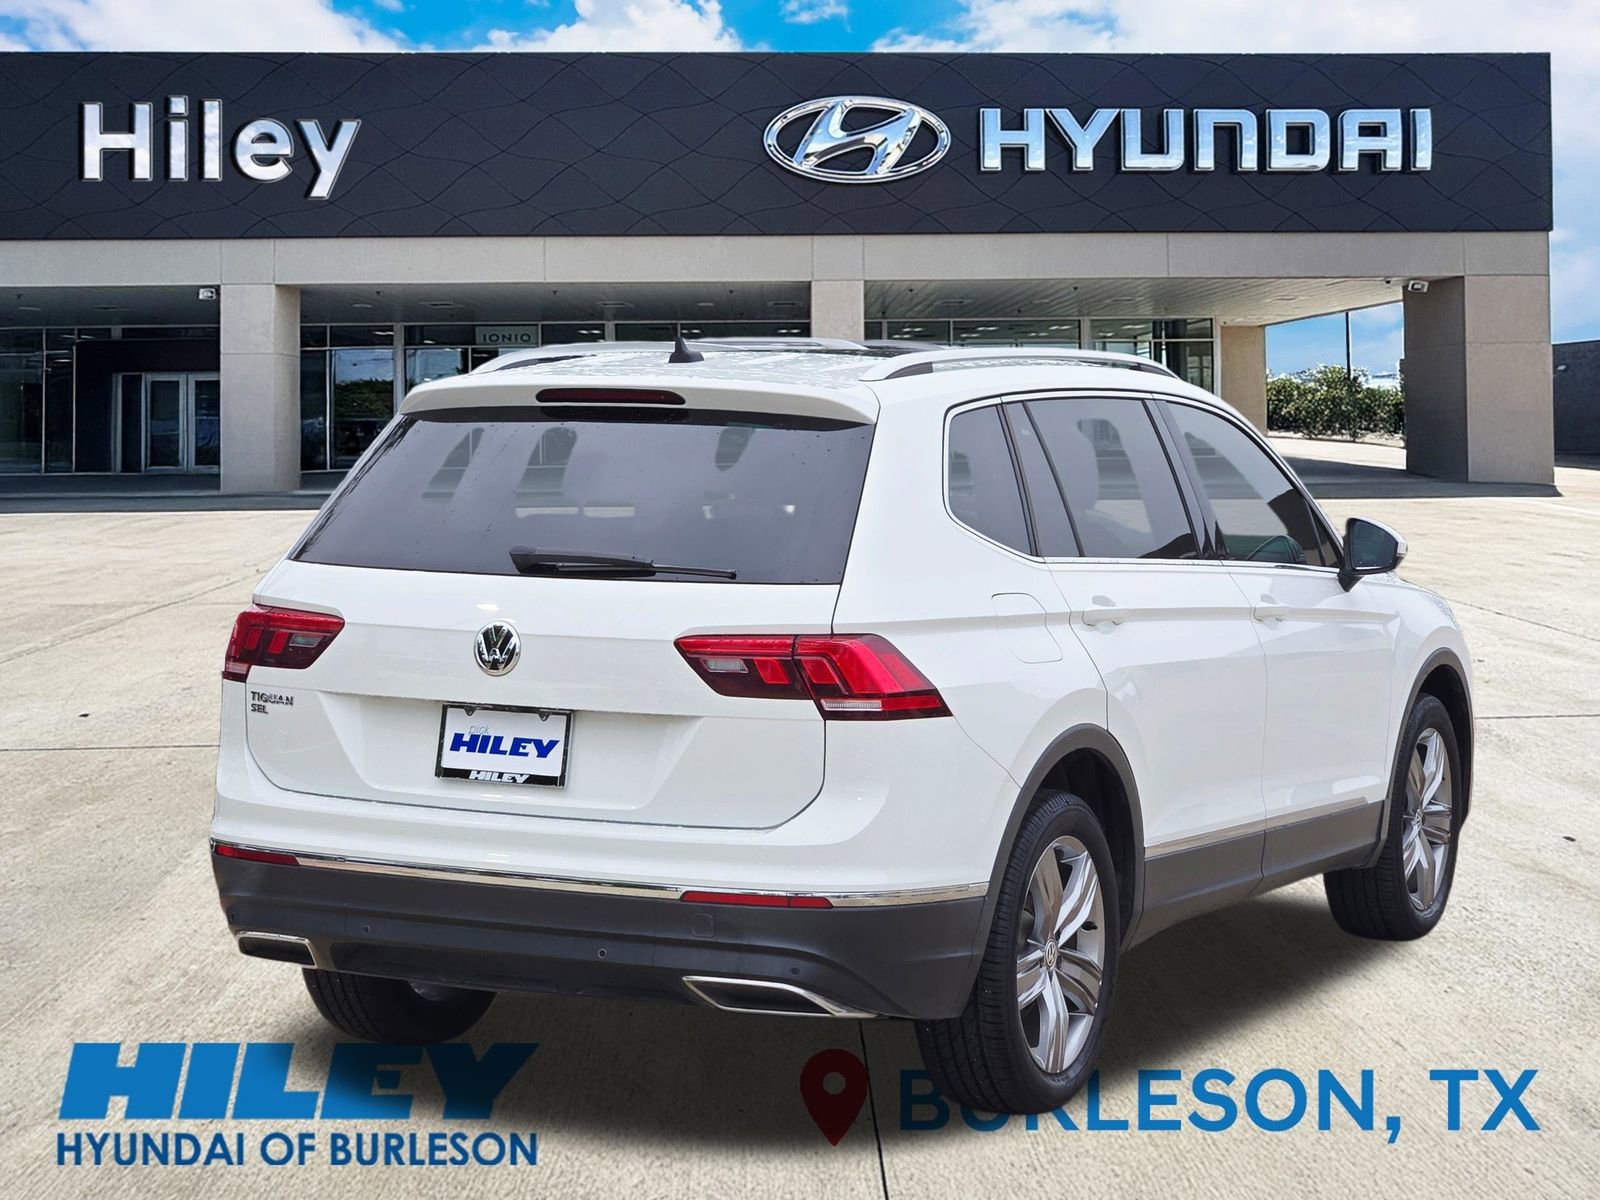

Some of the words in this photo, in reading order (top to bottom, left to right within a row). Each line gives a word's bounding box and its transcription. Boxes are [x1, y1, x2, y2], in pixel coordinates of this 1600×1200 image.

[80, 96, 362, 200] Hiley
[979, 107, 1434, 173] HYUNDAI
[483, 333, 531, 343] IONIQ
[251, 703, 269, 714] SEL
[449, 732, 560, 758] HILEY
[468, 770, 530, 784] HILEY
